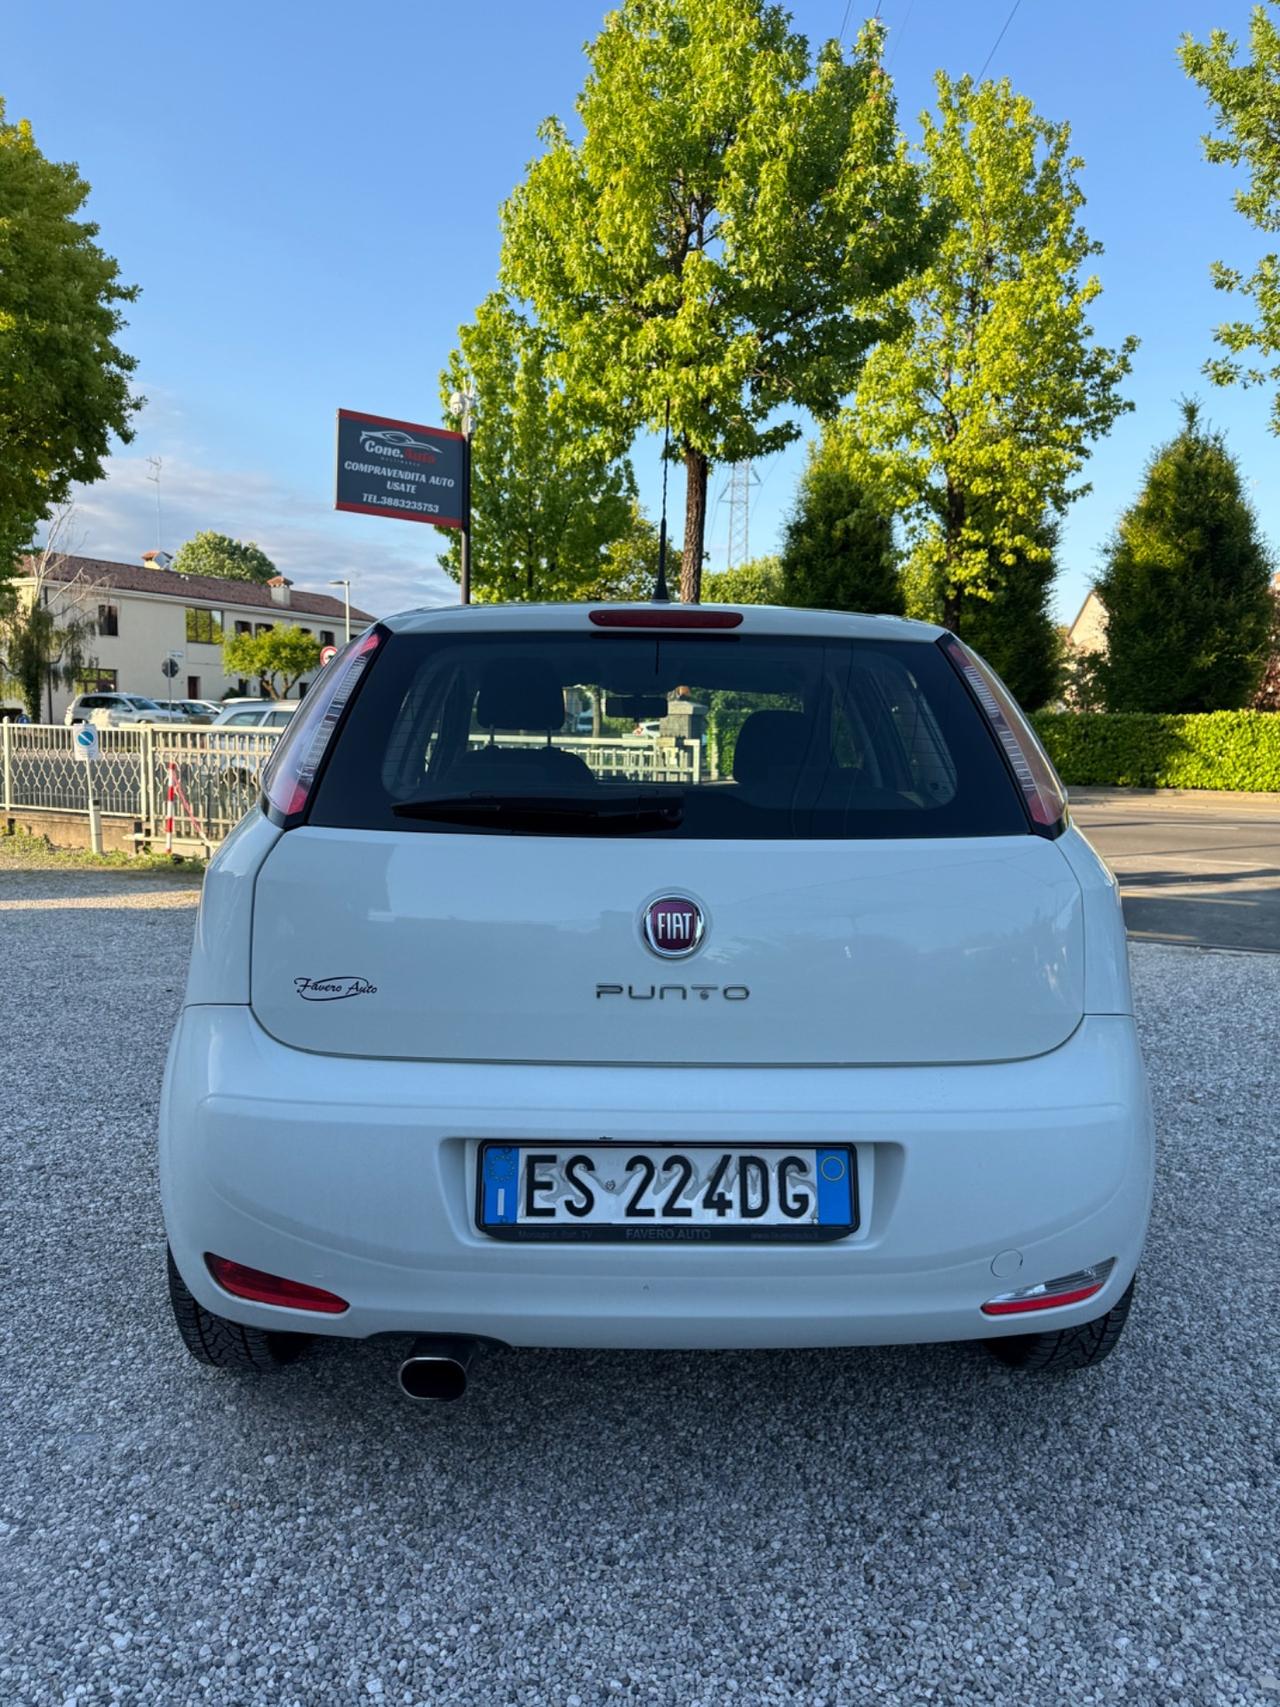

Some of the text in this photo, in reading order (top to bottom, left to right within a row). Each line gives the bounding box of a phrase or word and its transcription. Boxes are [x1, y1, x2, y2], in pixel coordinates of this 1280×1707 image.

[344, 461, 426, 483] COMPRAVENDITA
[429, 475, 455, 488] AUTO
[386, 481, 417, 494] USATE
[657, 912, 692, 940] FIAT
[294, 977, 378, 995] Favero Auto
[596, 983, 750, 1001] PUNTO
[525, 1154, 810, 1218] ES 224DG
[625, 1228, 711, 1240] FAVERO AUTO
